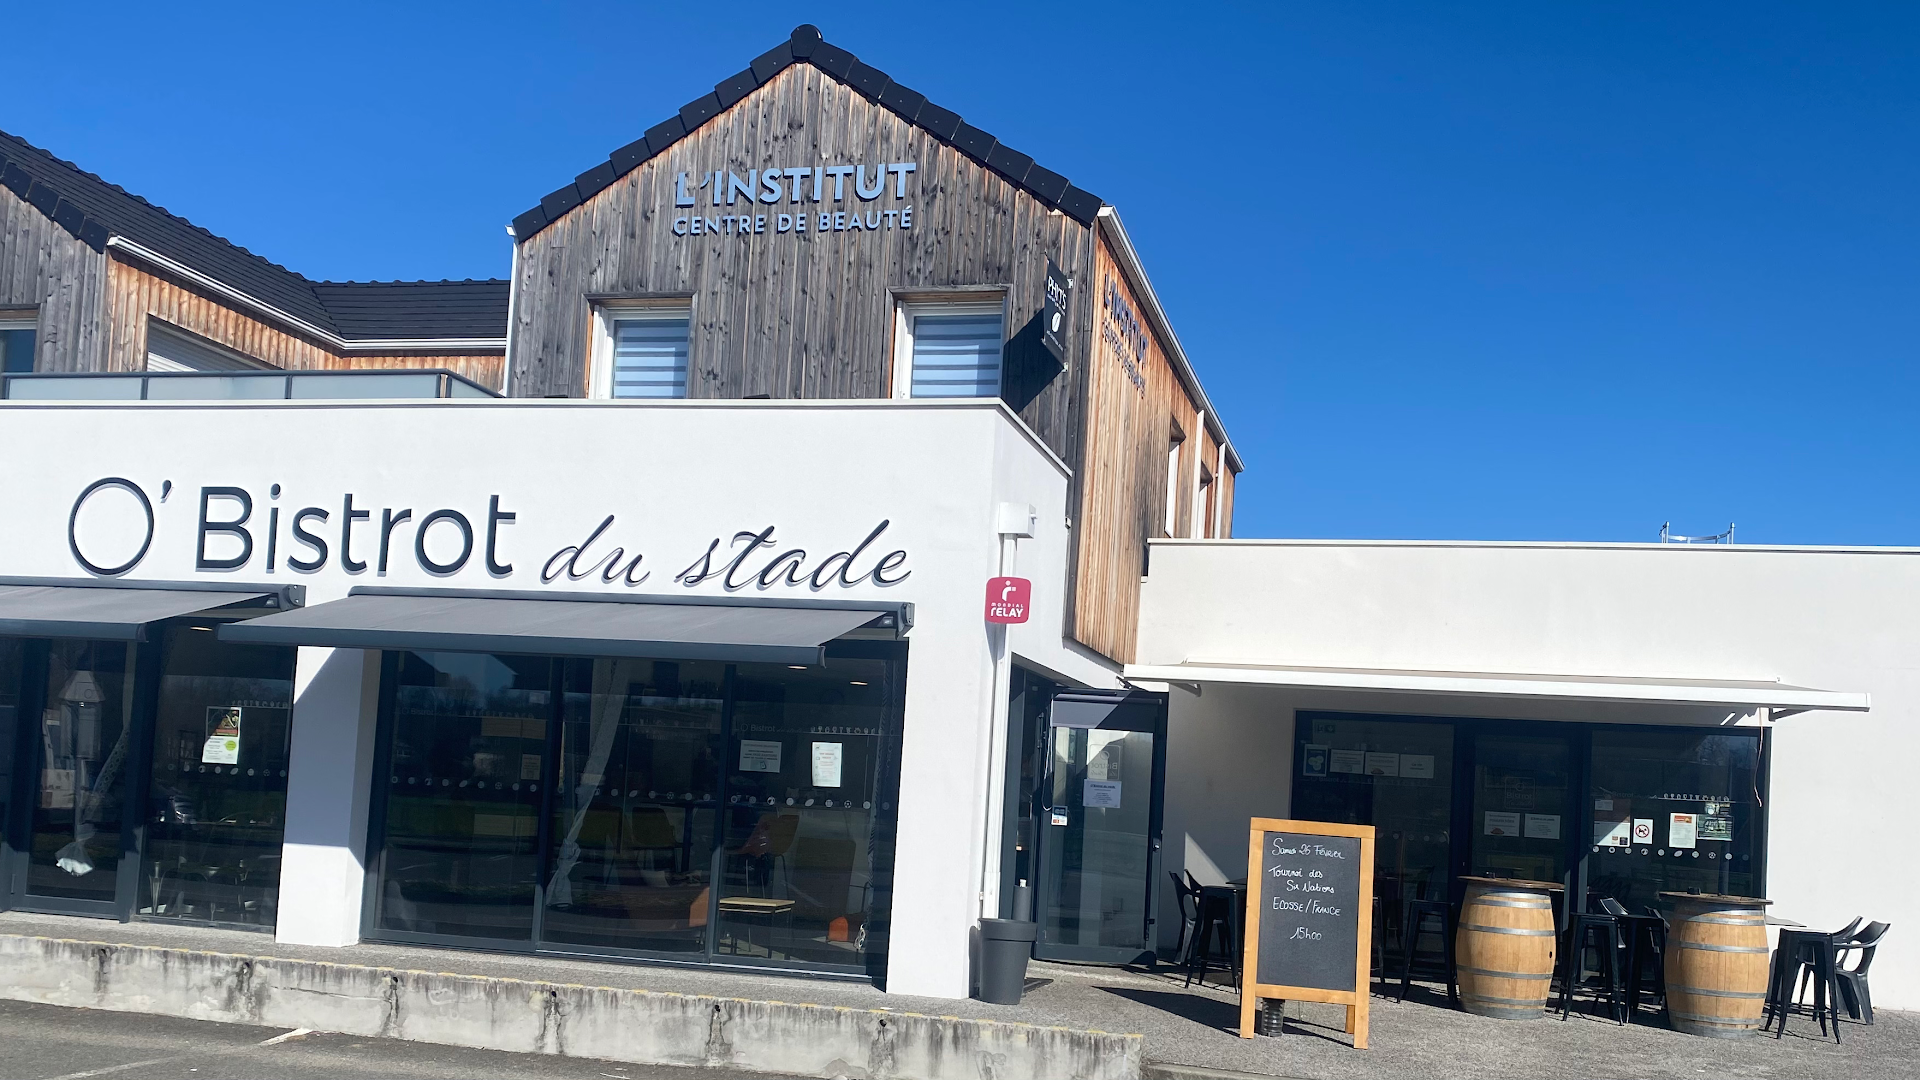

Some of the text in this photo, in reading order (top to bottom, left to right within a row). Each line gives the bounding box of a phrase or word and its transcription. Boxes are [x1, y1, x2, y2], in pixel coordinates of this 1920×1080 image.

[676, 163, 916, 206] L'INSTITUT
[673, 205, 912, 235] CENTRE DE BEAUTÉ
[195, 483, 516, 578] Bistrot
[540, 514, 651, 585] du
[673, 519, 912, 592] stade
[1268, 864, 1324, 879] Tournoi des
[1302, 880, 1335, 894] Nations
